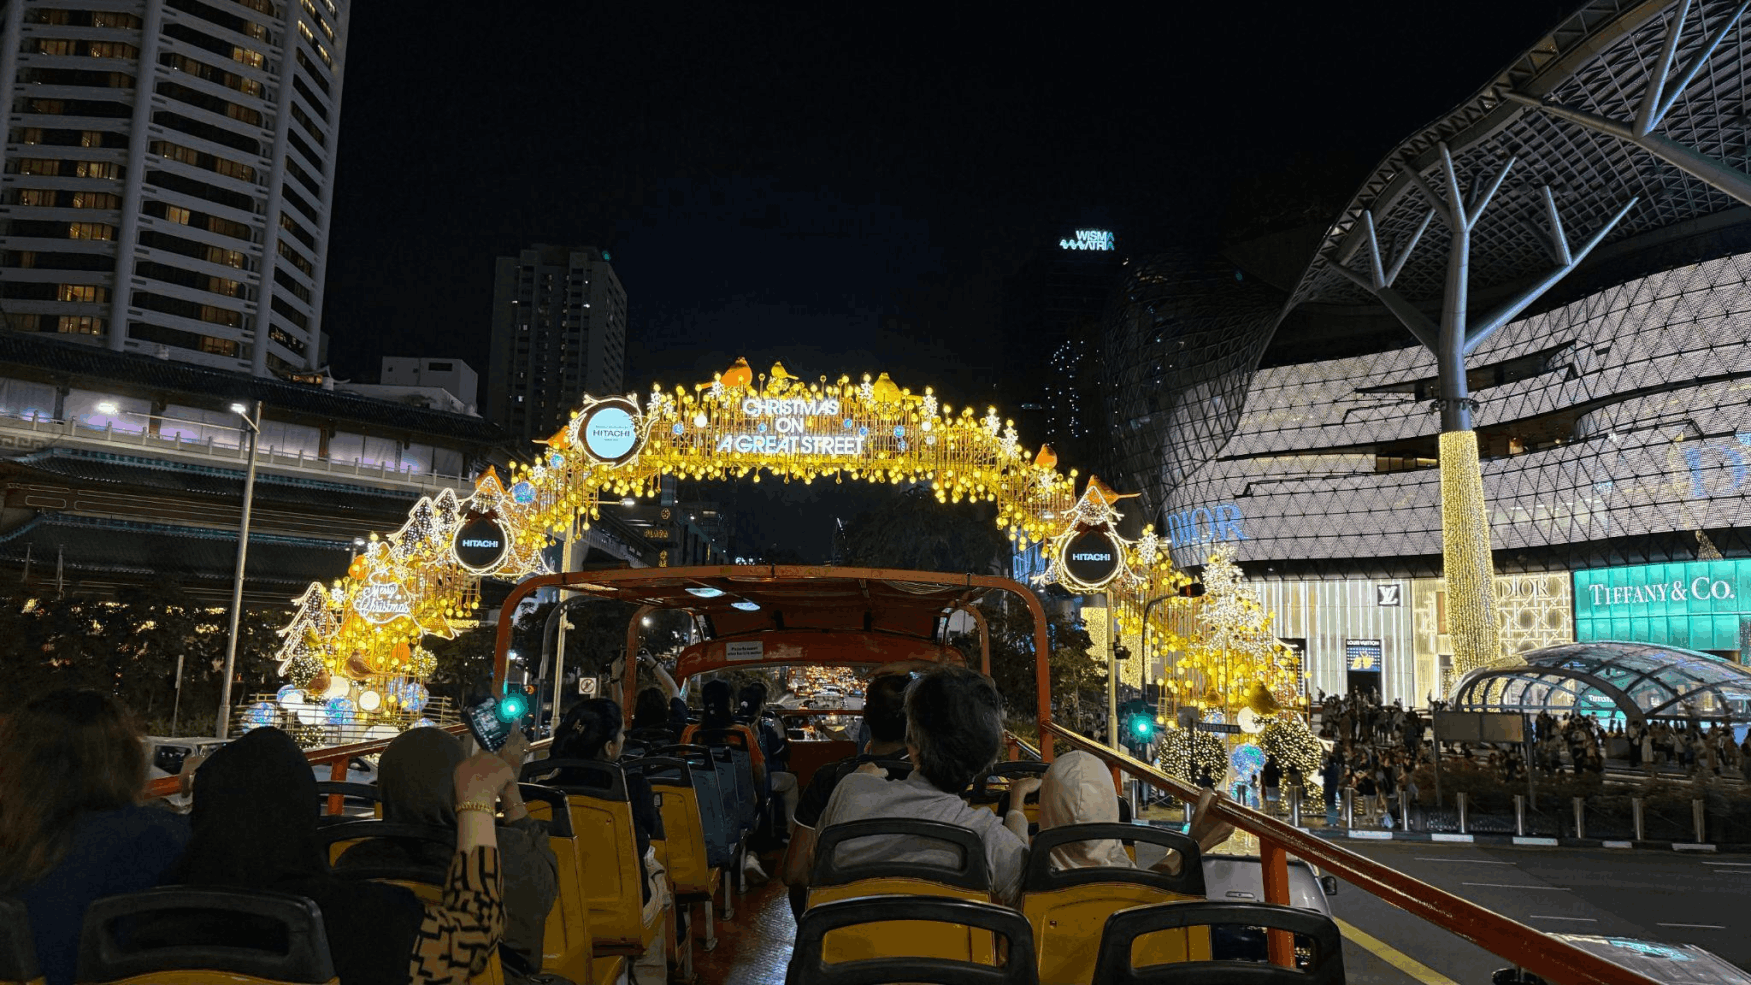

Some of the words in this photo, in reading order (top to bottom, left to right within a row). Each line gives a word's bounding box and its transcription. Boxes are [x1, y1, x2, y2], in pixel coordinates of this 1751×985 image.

[1076, 230, 1114, 241] WISMA
[742, 399, 840, 417] CHRISTMAS
[775, 417, 804, 433] ON
[717, 434, 733, 453] A
[735, 434, 798, 454] GREAT
[800, 436, 864, 455] STREET
[1167, 504, 1248, 547] DIOR
[462, 539, 499, 548] HITACHI
[1072, 553, 1111, 561] HITACHI
[363, 582, 399, 600] Merry
[1500, 579, 1549, 597] DIOR
[1589, 583, 1669, 606] TIFFANY
[1671, 580, 1688, 601] &
[353, 599, 410, 617] Christmas
